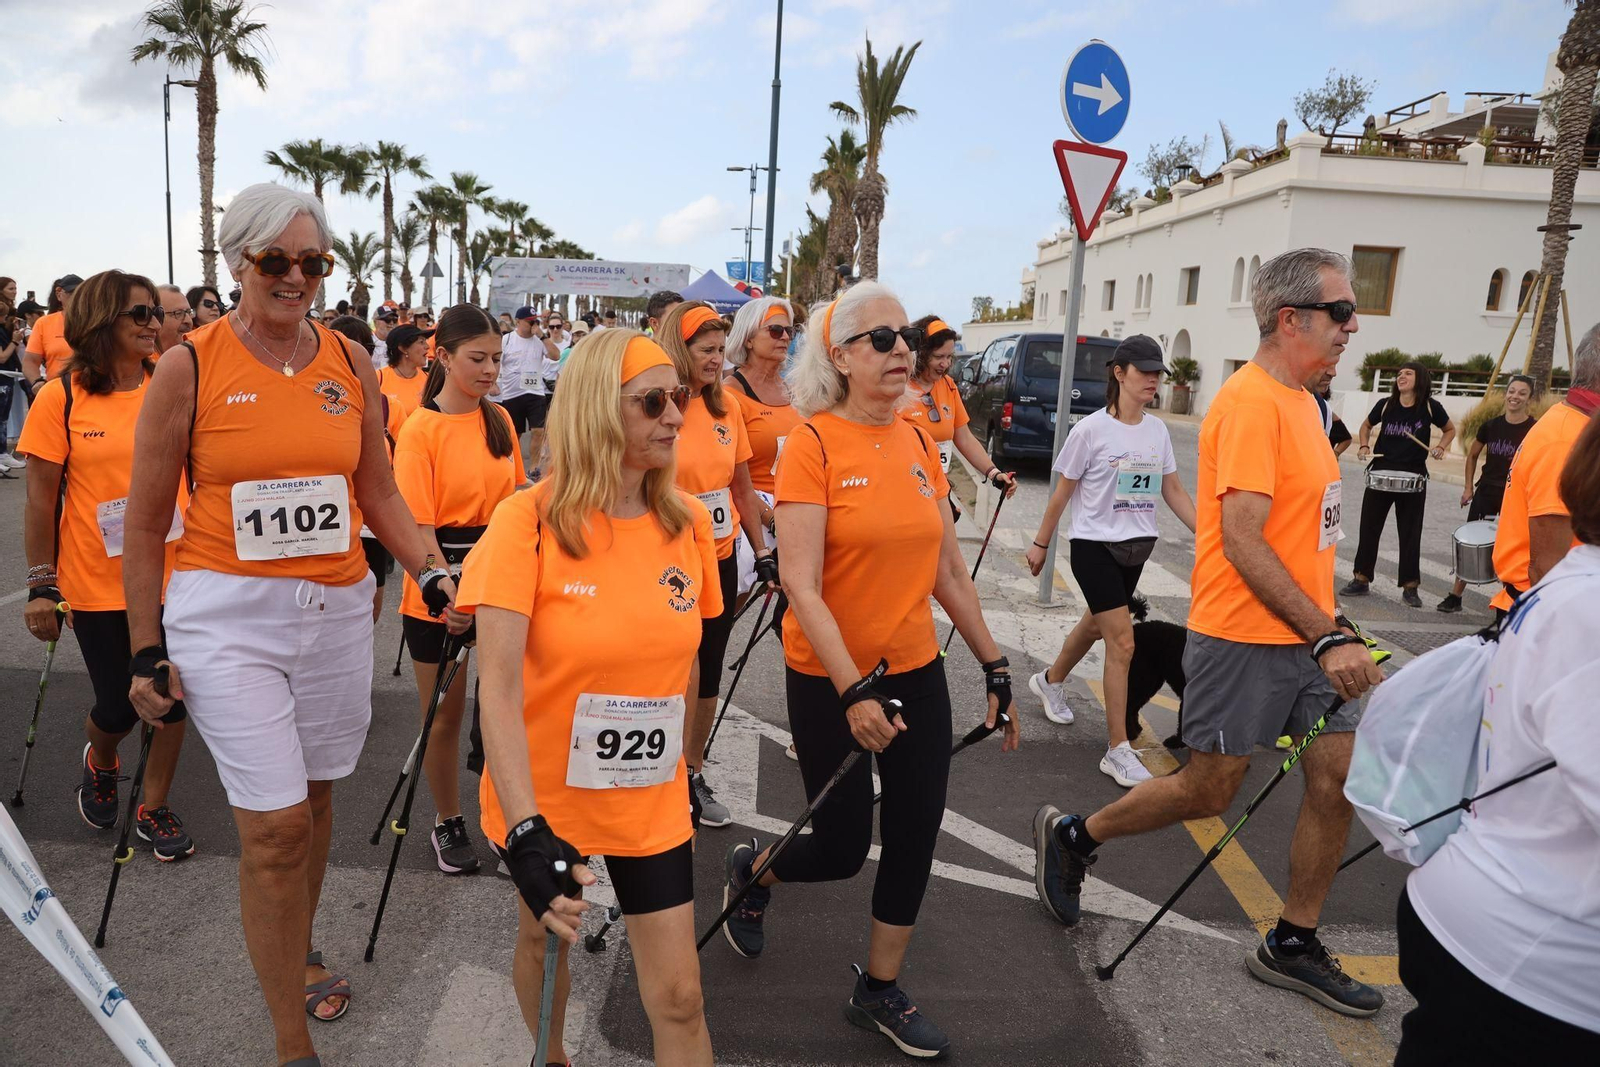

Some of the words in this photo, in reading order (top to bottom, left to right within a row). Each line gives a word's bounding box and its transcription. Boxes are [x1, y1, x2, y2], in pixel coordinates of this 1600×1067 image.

[568, 266, 612, 274] CARRERA
[270, 480, 310, 490] CARRERA
[1132, 474, 1150, 488] 21
[244, 503, 340, 536] 1102
[1324, 503, 1340, 529] 928
[620, 700, 657, 708] CARRERA
[596, 729, 666, 760] 929
[1288, 724, 1320, 765] FIZAN
